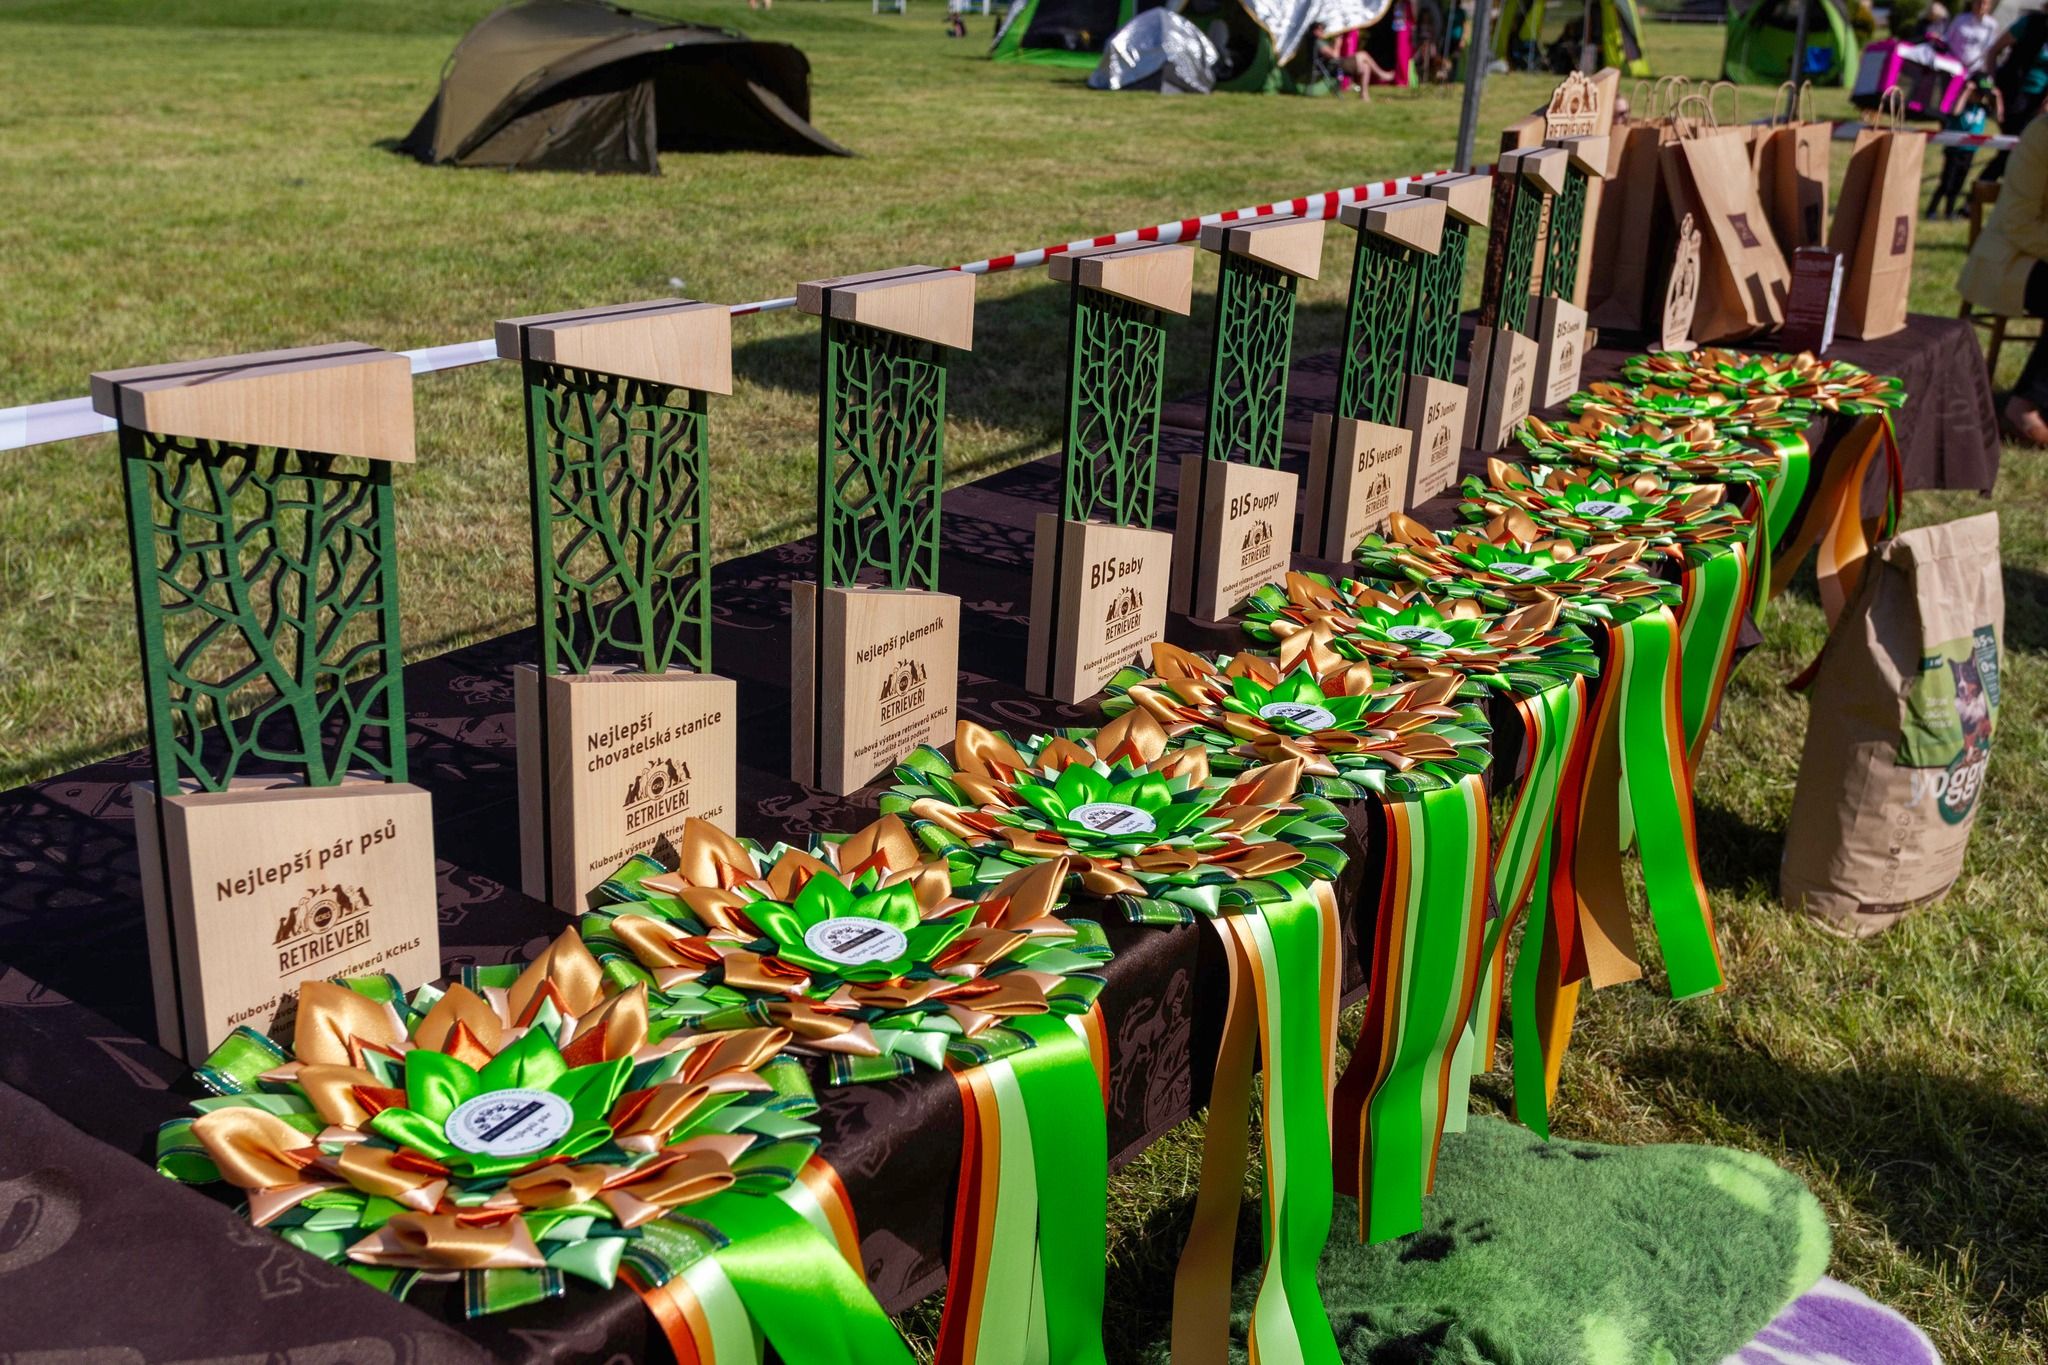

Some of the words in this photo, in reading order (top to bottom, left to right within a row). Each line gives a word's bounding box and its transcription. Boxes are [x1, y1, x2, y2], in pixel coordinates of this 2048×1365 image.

[1427, 402, 1441, 424] BIS
[1358, 448, 1375, 473] BIS
[1377, 443, 1403, 464] Veterán
[1230, 493, 1252, 520] BIS
[1253, 491, 1279, 511] Puppy
[1091, 557, 1117, 590] BIS
[1118, 557, 1144, 578] Baby
[856, 635, 898, 665] Nejlepší
[900, 616, 944, 650] plemeník
[1106, 614, 1141, 641] RETRIEVEŘI
[881, 688, 925, 722] RETRIEVEŘI
[588, 712, 653, 752] Nejlepší
[588, 728, 671, 772] chovatelská
[675, 711, 722, 739] stanice
[854, 739, 879, 758] Klubová
[879, 731, 901, 746] výstava
[902, 715, 929, 735] retrieverů
[930, 706, 948, 720] KCHLS
[627, 790, 689, 831] RETRIEVEŘI
[216, 849, 312, 901] Nejlepší
[319, 837, 352, 870] pár
[360, 819, 396, 853] psů
[589, 849, 624, 871] Klubová
[625, 837, 656, 856] výstava
[280, 919, 370, 972] RETRIEVEŘI
[227, 995, 276, 1026] Klubová
[386, 937, 421, 959] KCHLS
